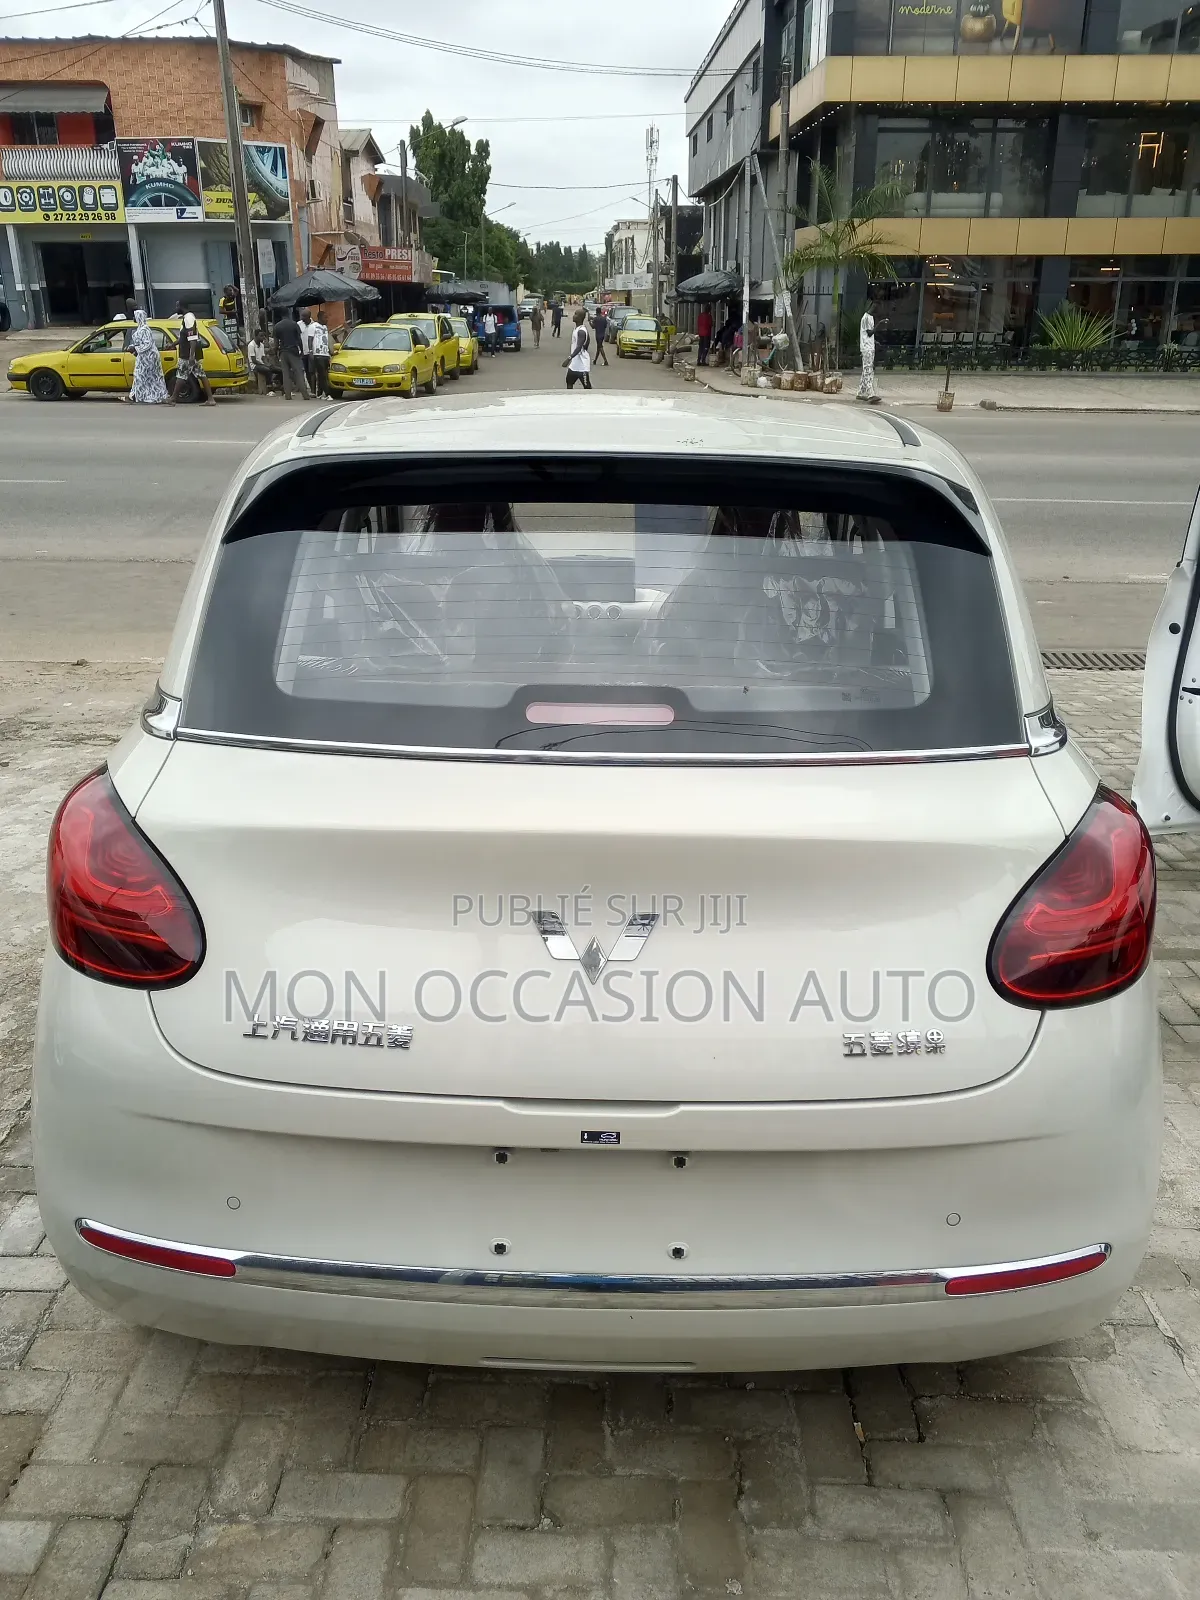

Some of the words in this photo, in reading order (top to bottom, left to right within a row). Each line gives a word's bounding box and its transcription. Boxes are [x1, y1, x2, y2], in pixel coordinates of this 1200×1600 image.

[899, 0, 953, 15] moderne
[53, 213, 64, 221] 27
[65, 213, 77, 221] 22
[78, 213, 89, 221] 29
[91, 213, 102, 221] 26
[105, 212, 116, 220] 98
[385, 248, 412, 260] PRESI
[243, 1013, 413, 1049] 上汽通用五菱
